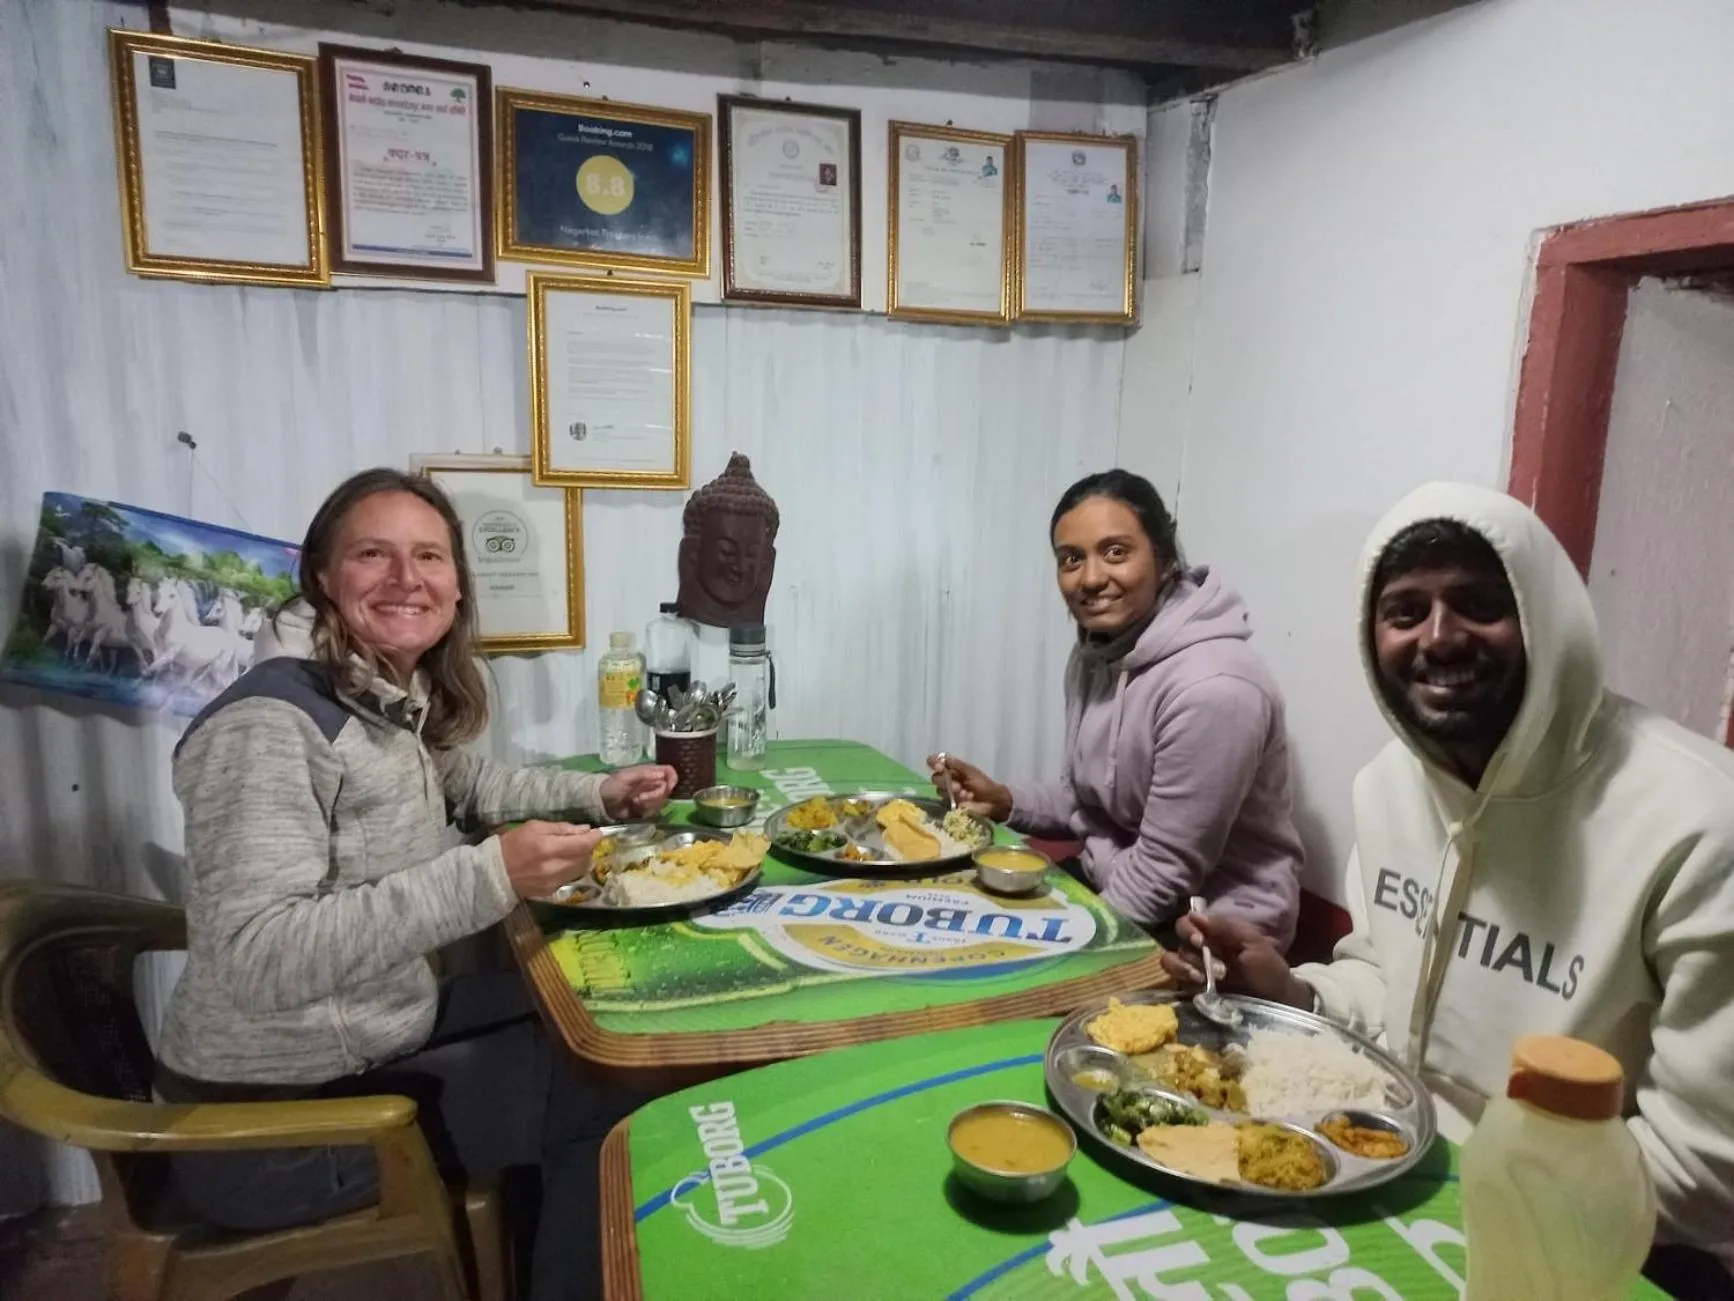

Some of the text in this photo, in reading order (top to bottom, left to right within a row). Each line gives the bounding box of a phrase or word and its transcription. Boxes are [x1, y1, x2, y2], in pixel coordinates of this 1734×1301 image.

[557, 132, 580, 143] Guest
[608, 139, 636, 150] Awards
[578, 123, 633, 138] Booking.com
[585, 173, 626, 198] 8.8
[778, 894, 1073, 944] TUBORG
[1373, 867, 1585, 1001] ESSTIALS
[818, 934, 1006, 964] COPENHAGEN
[688, 1100, 770, 1226] TUBORG
